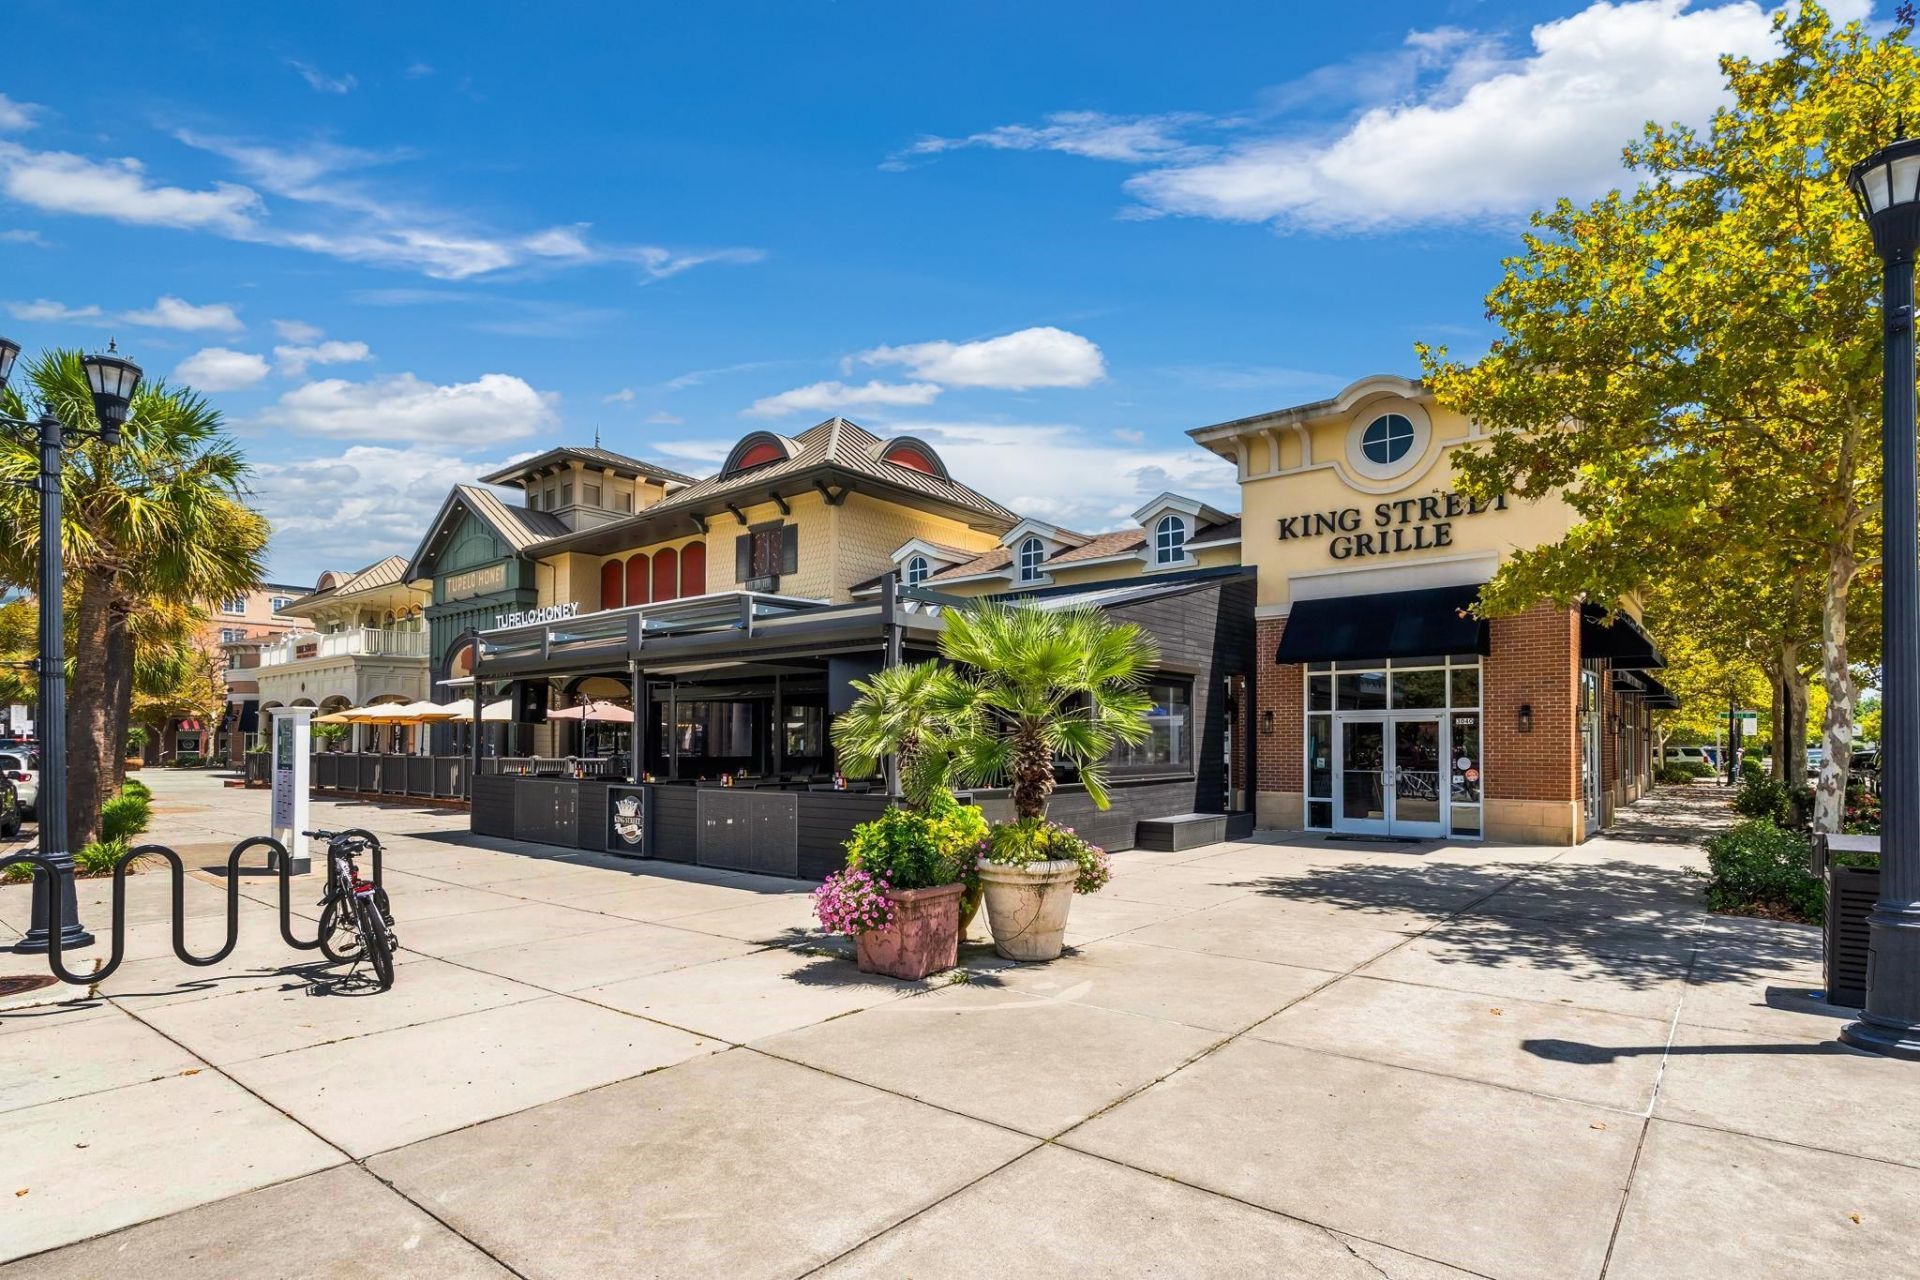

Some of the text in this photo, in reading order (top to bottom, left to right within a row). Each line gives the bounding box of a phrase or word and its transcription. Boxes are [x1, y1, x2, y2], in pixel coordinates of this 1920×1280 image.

[1277, 509, 1361, 540] KING
[1329, 522, 1453, 559] GRILLE
[446, 574, 475, 592] TUPELO
[496, 602, 578, 628] TUPELO HONEY
